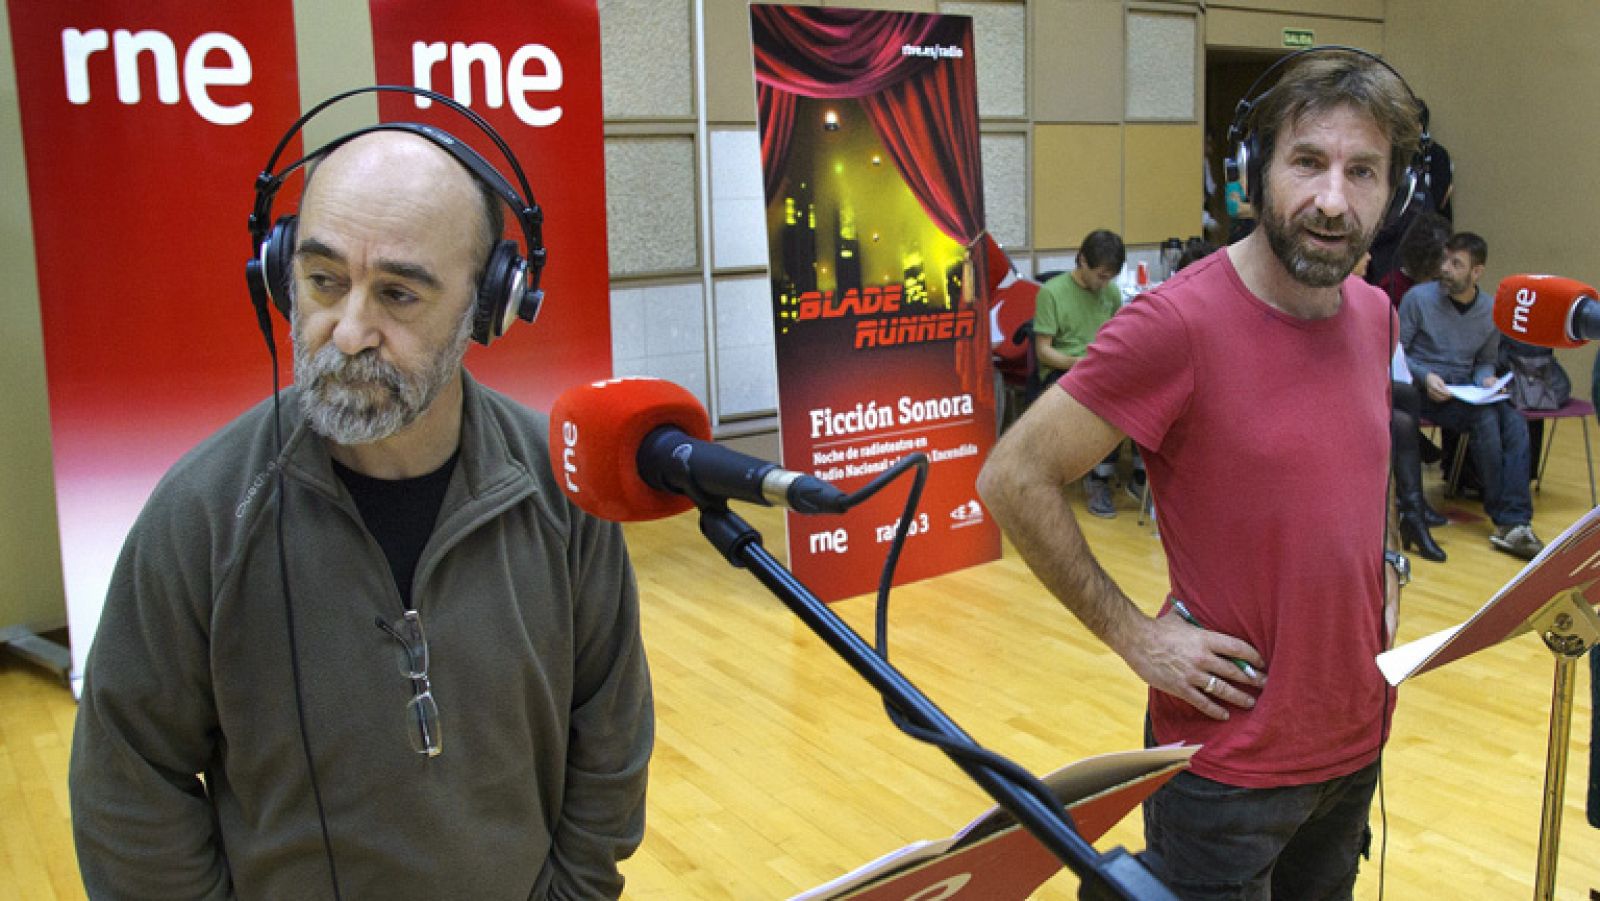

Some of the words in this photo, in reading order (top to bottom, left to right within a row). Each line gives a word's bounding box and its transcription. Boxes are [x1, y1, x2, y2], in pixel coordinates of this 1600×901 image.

[62, 27, 254, 125] rne
[412, 41, 563, 127] rne
[799, 285, 903, 320] BLADE
[1512, 287, 1536, 333] rne
[855, 310, 976, 349] RUNNER
[809, 400, 895, 438] Ficción
[898, 393, 974, 424] Sonora
[562, 421, 580, 493] rne
[812, 450, 845, 465] Noche
[846, 446, 859, 460] de
[860, 440, 914, 456] radioteatro
[915, 437, 928, 448] en
[845, 460, 889, 478] Nacional
[809, 527, 849, 554] rne
[919, 512, 930, 534] 3
